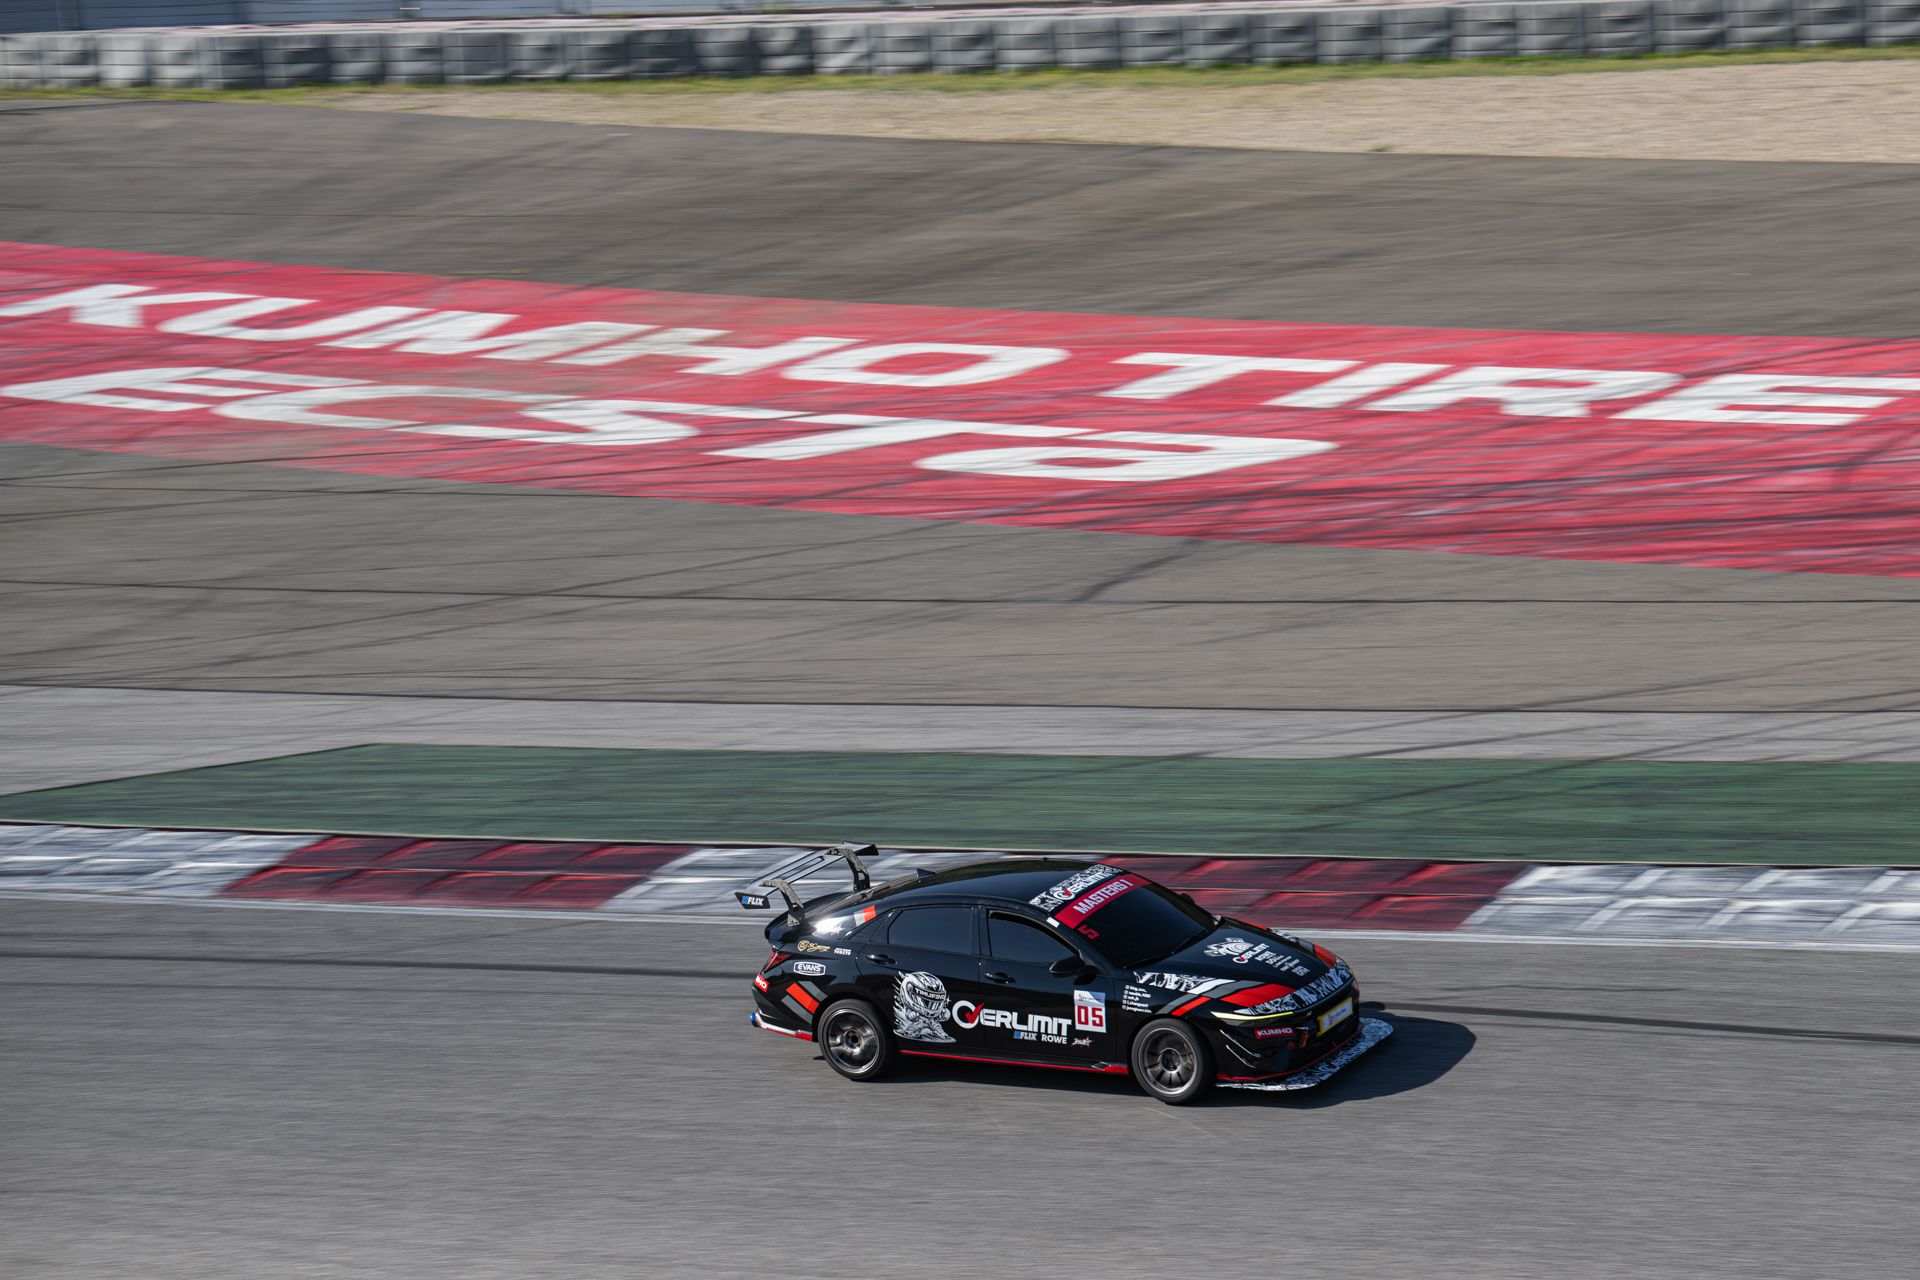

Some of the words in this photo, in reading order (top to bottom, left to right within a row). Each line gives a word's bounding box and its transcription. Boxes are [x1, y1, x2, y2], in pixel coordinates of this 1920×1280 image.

[0, 284, 1072, 387] KUMHO
[1098, 352, 1920, 426] TIRE
[797, 963, 821, 972] EVANS
[1077, 1005, 1104, 1027] 05
[1256, 1027, 1293, 1037] KUMHO
[1041, 1034, 1068, 1045] ROWE
